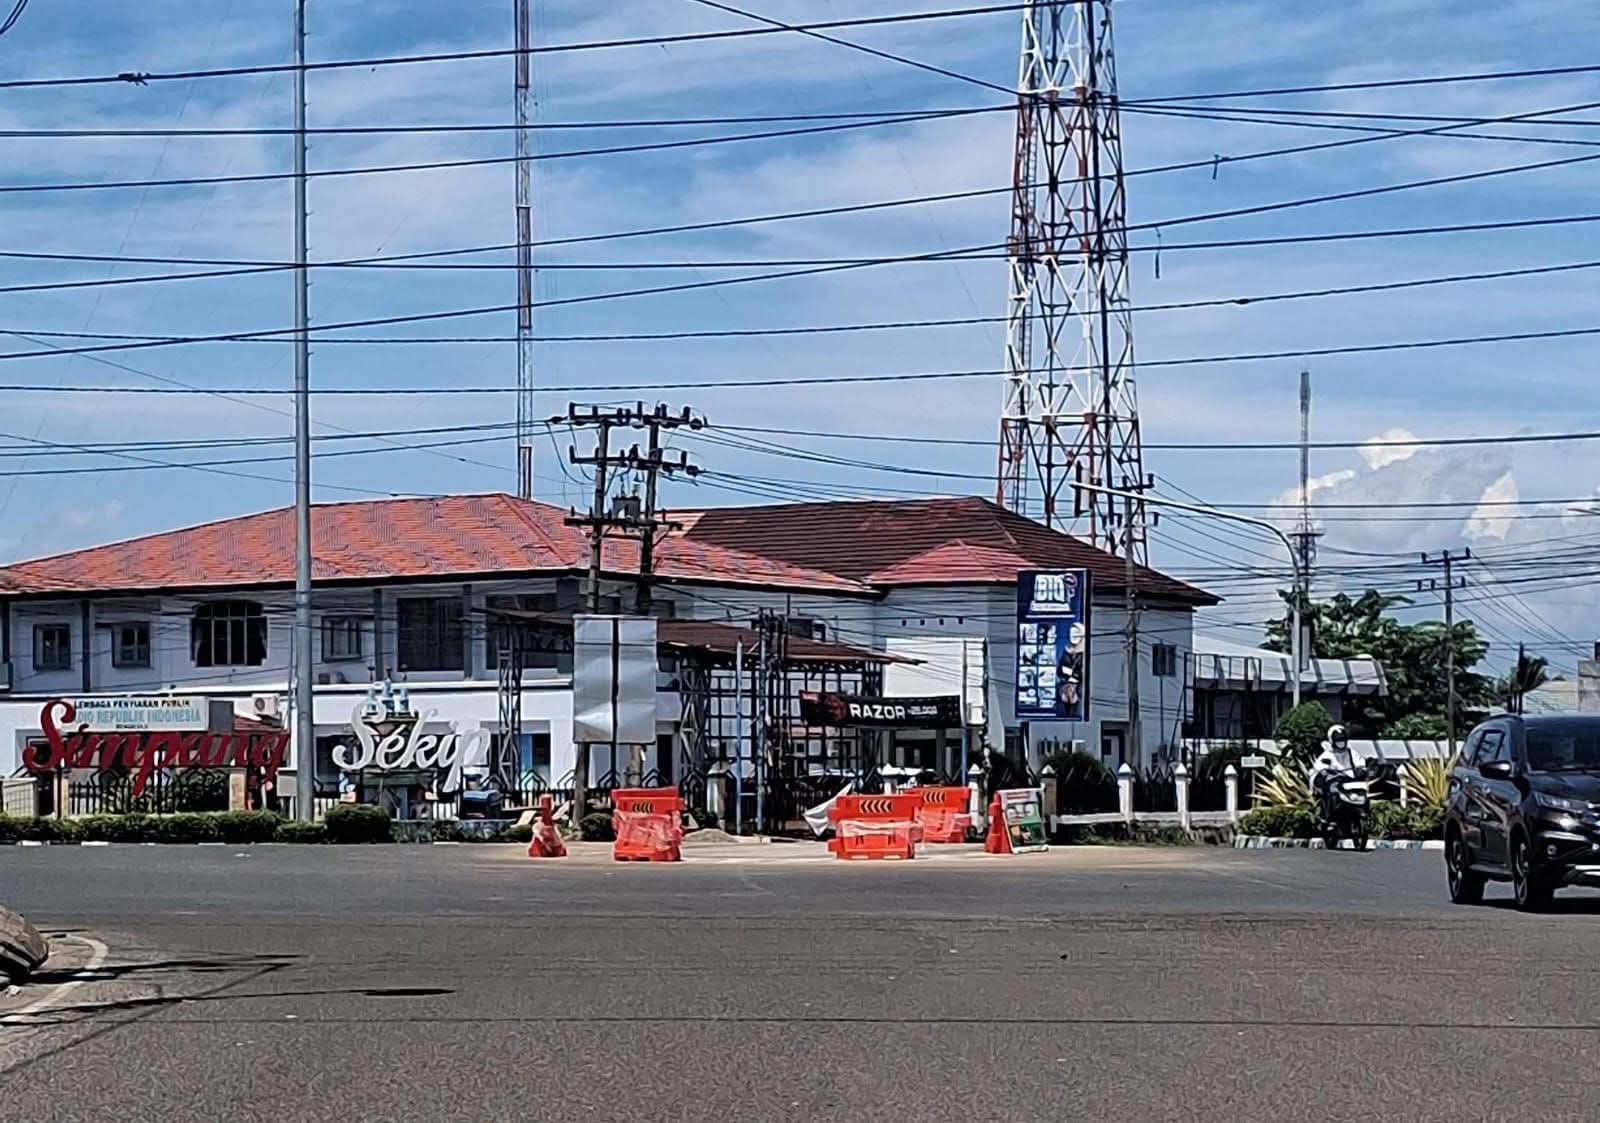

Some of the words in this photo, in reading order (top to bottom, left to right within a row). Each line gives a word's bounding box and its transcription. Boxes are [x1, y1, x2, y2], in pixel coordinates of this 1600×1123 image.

[96, 709, 144, 723] REPUBLIK
[147, 708, 200, 722] INDONESIA
[850, 703, 906, 719] RAZOR
[22, 700, 291, 799] Simpang
